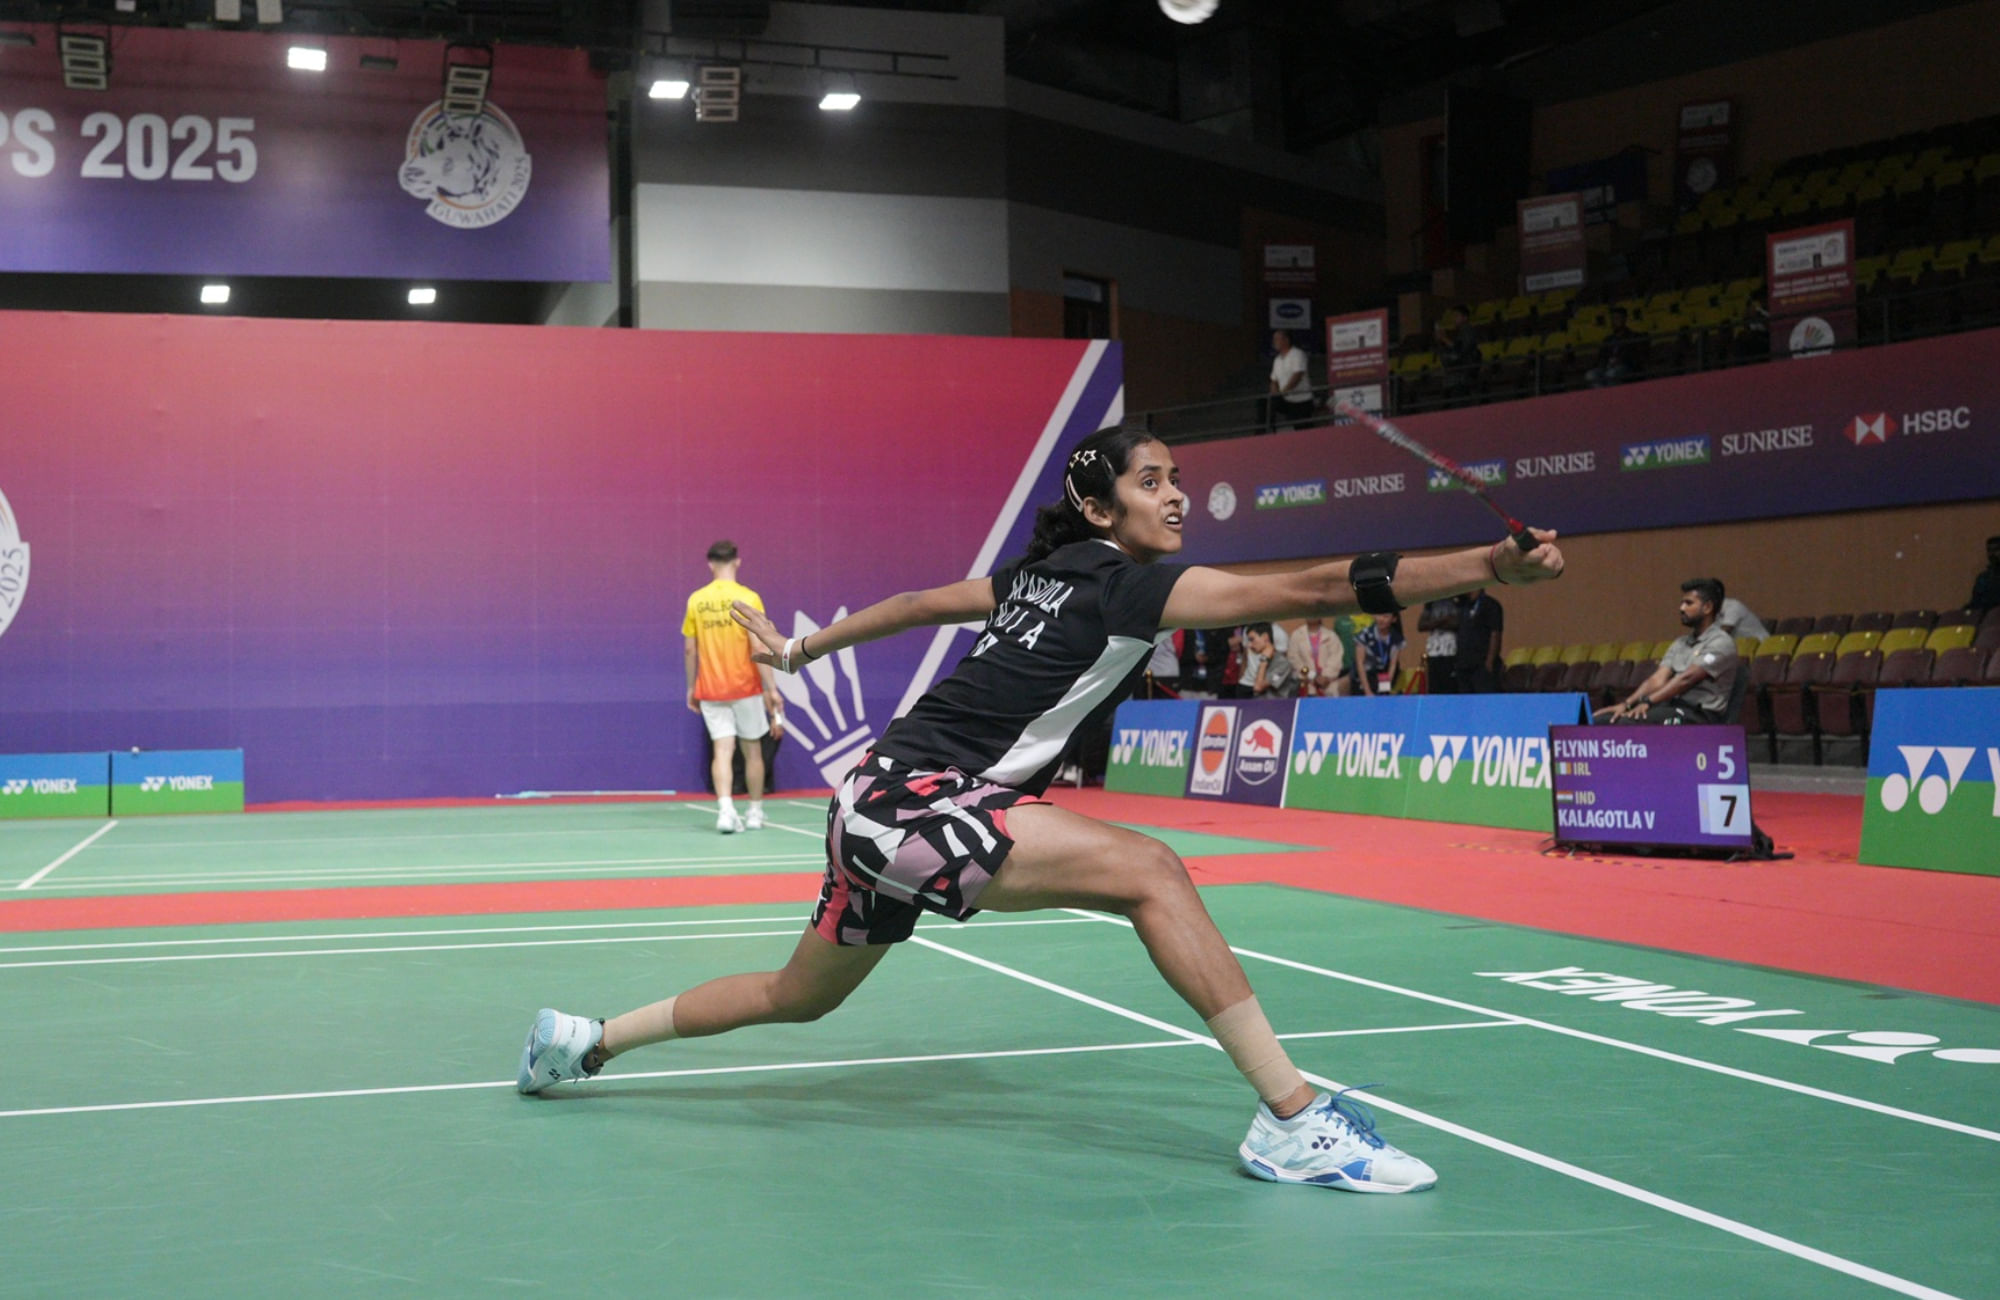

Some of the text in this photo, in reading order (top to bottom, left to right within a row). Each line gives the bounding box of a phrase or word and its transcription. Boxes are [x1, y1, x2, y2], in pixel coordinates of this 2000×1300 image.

[0, 108, 257, 183] S 2025
[1903, 406, 1971, 436] HSBC
[1654, 425, 1814, 464] YONEX SUNRISE
[1458, 450, 1597, 483] ONEX SUNRISE
[1282, 473, 1406, 504] YONEX SUNRISE
[1140, 729, 1188, 768] YONEX
[1336, 731, 1405, 779] YONEX
[1471, 735, 1552, 790] YONEX
[1553, 739, 1648, 758] FLYNN Siofra
[1696, 752, 1707, 771] 0
[1717, 745, 1735, 780] 5
[1239, 759, 1263, 773] Assam
[1573, 762, 1592, 776] IRL
[31, 778, 77, 794] YONEX
[169, 776, 213, 791] YONEX
[1575, 790, 1596, 805] IND
[1558, 809, 1655, 829] KALAGOTLA V
[1720, 795, 1737, 827] 7
[1473, 966, 1805, 1025] YONEX
